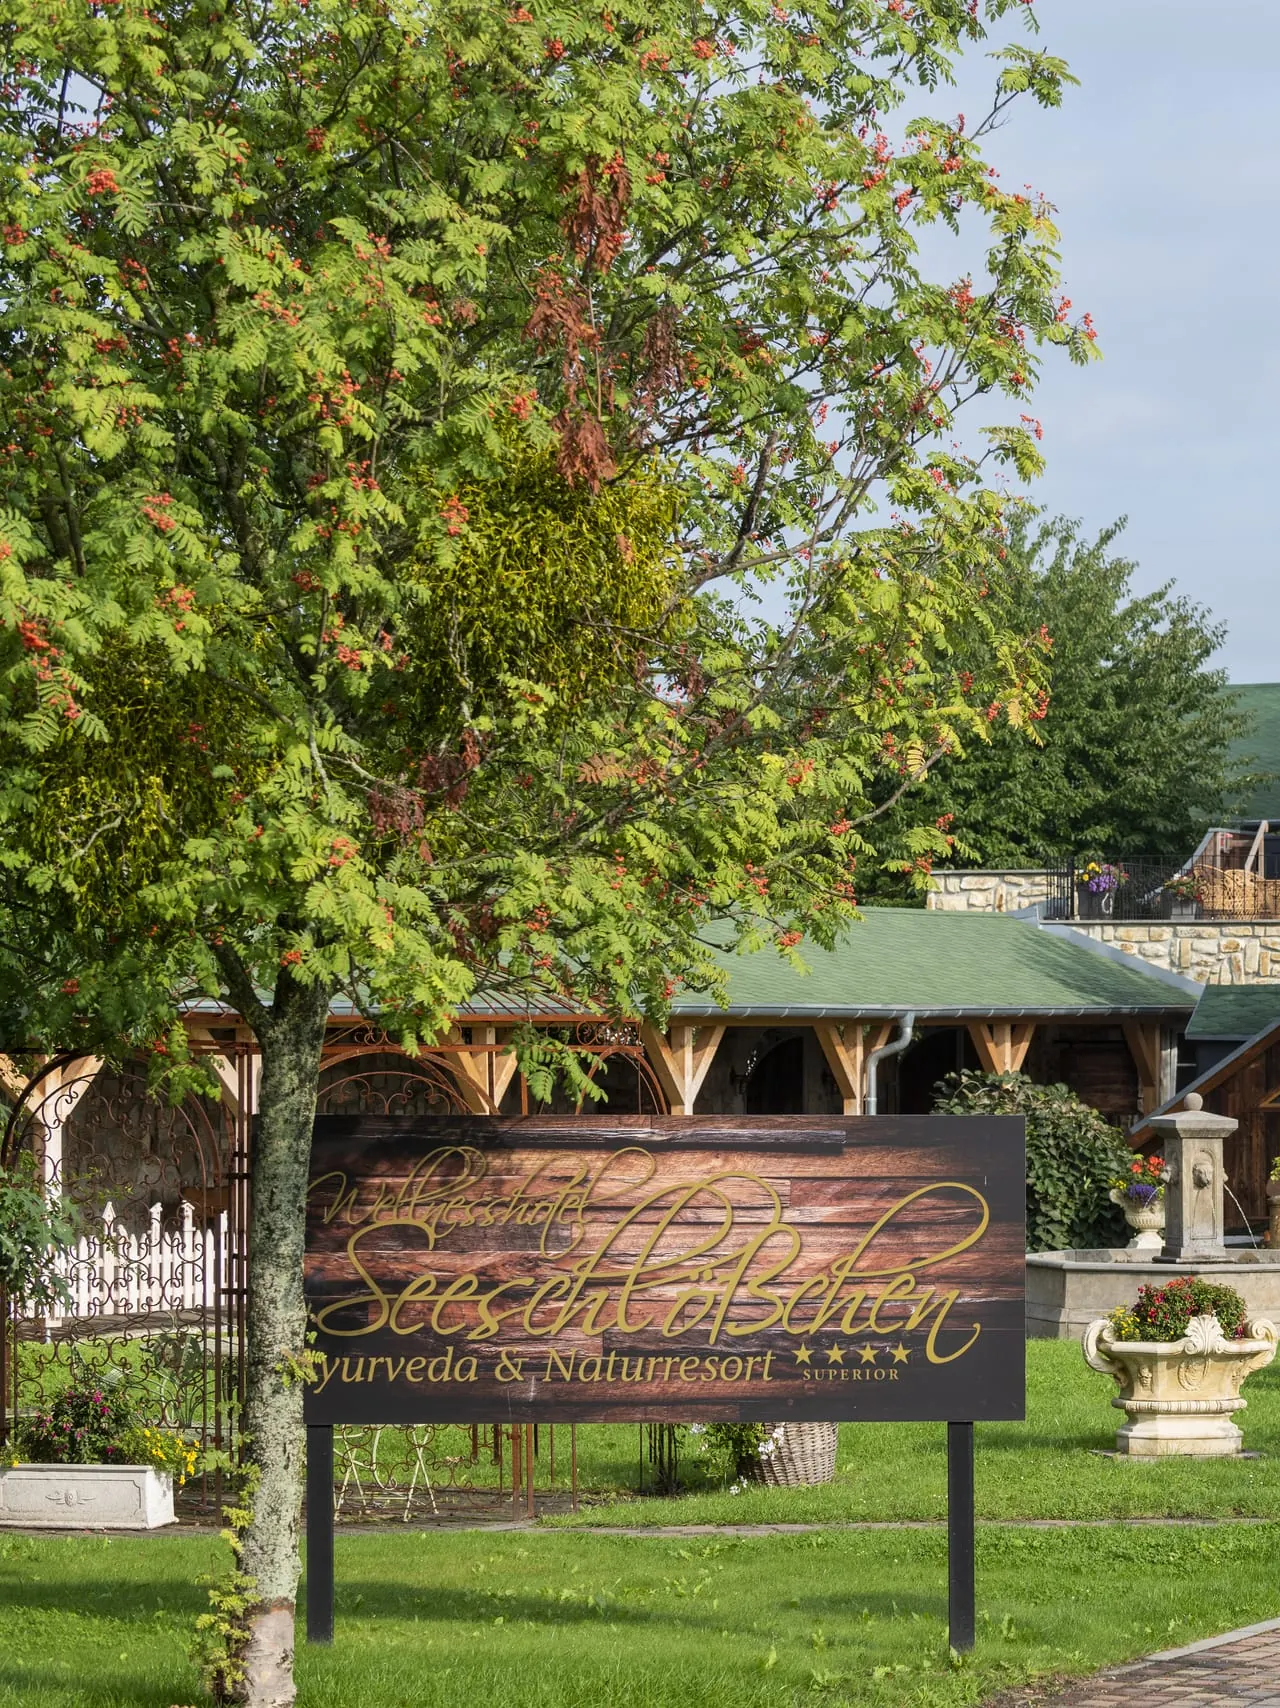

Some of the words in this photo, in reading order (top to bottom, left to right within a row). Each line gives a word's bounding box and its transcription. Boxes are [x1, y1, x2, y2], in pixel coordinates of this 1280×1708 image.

[306, 1146, 655, 1259] Wellnesshotel
[317, 1171, 990, 1364] Seeschlößchen
[494, 1348, 529, 1382] &
[542, 1348, 777, 1383] Naturresort
[802, 1368, 900, 1381] SUPERIOR
